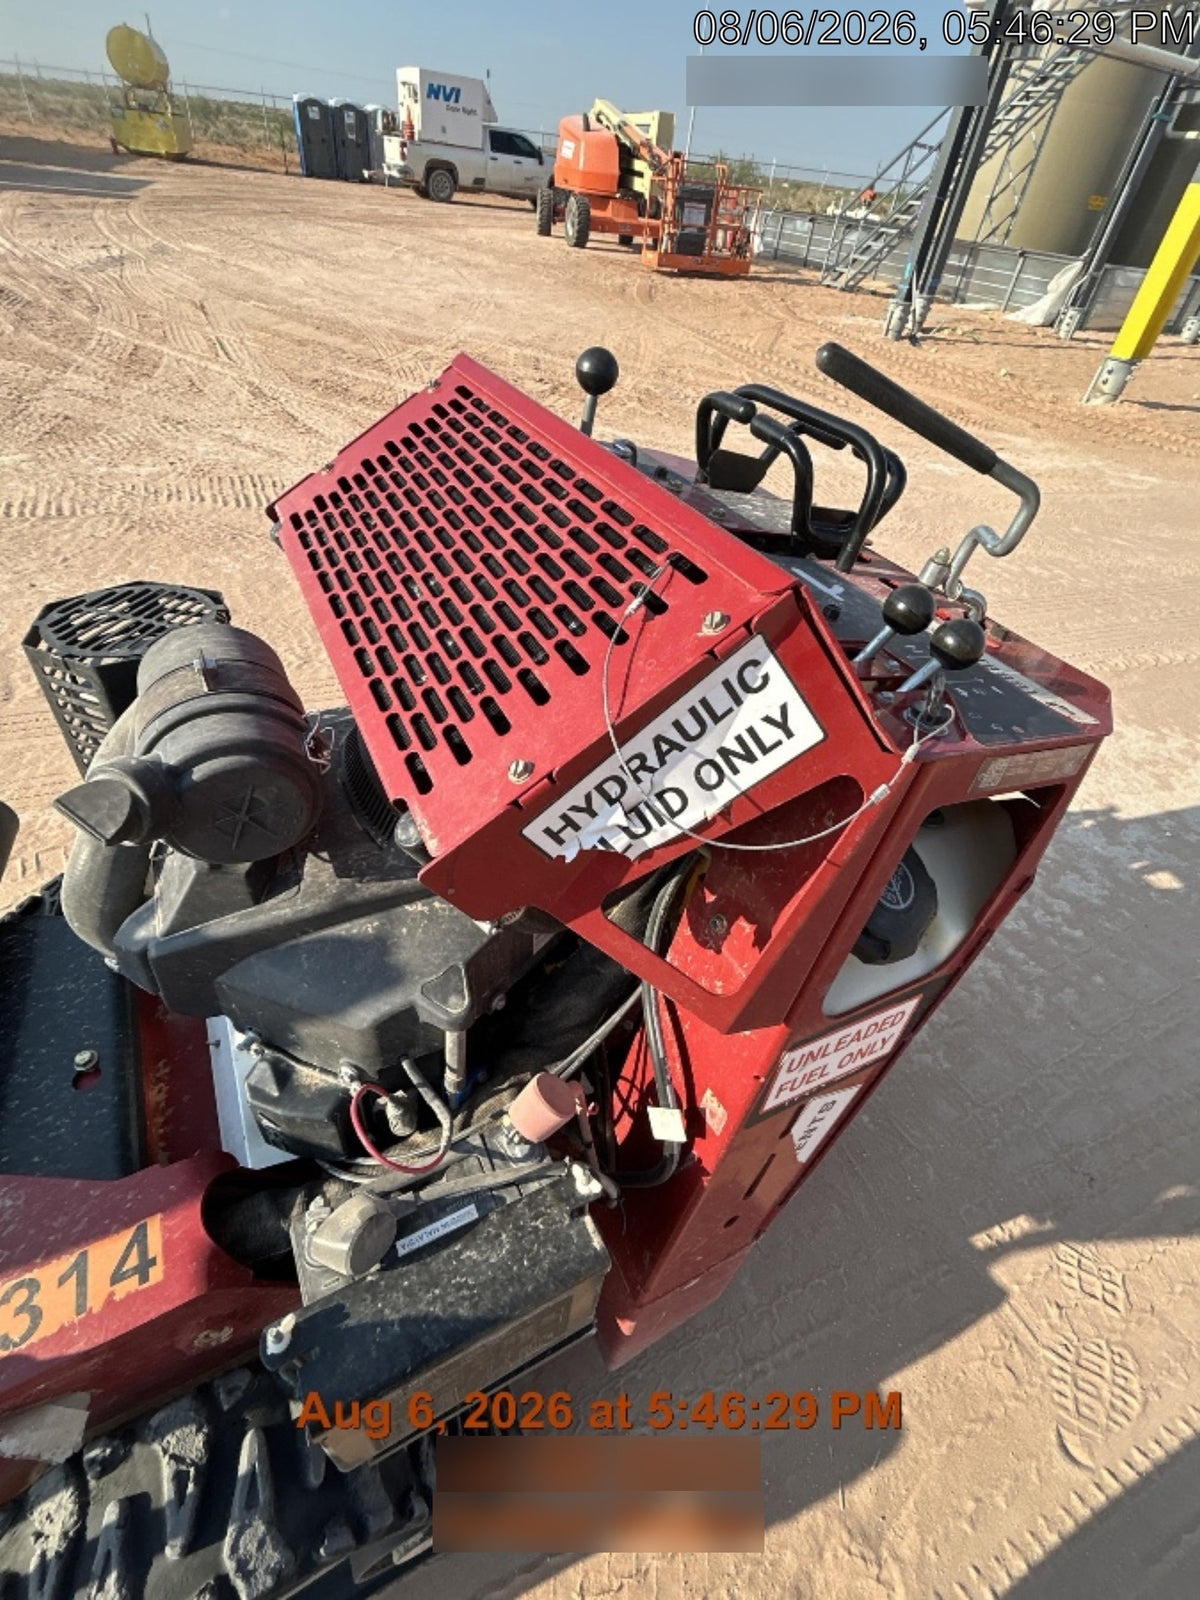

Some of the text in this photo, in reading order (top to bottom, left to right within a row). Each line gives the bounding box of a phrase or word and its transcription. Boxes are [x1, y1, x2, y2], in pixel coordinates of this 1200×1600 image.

[426, 83, 461, 103] NVI
[542, 658, 770, 847] HYDRAULIC
[592, 702, 796, 854] LUID ONLY
[775, 1032, 895, 1099] FUEL ONLY
[786, 1011, 905, 1074] UNLEADED
[0, 1221, 157, 1350] 314
